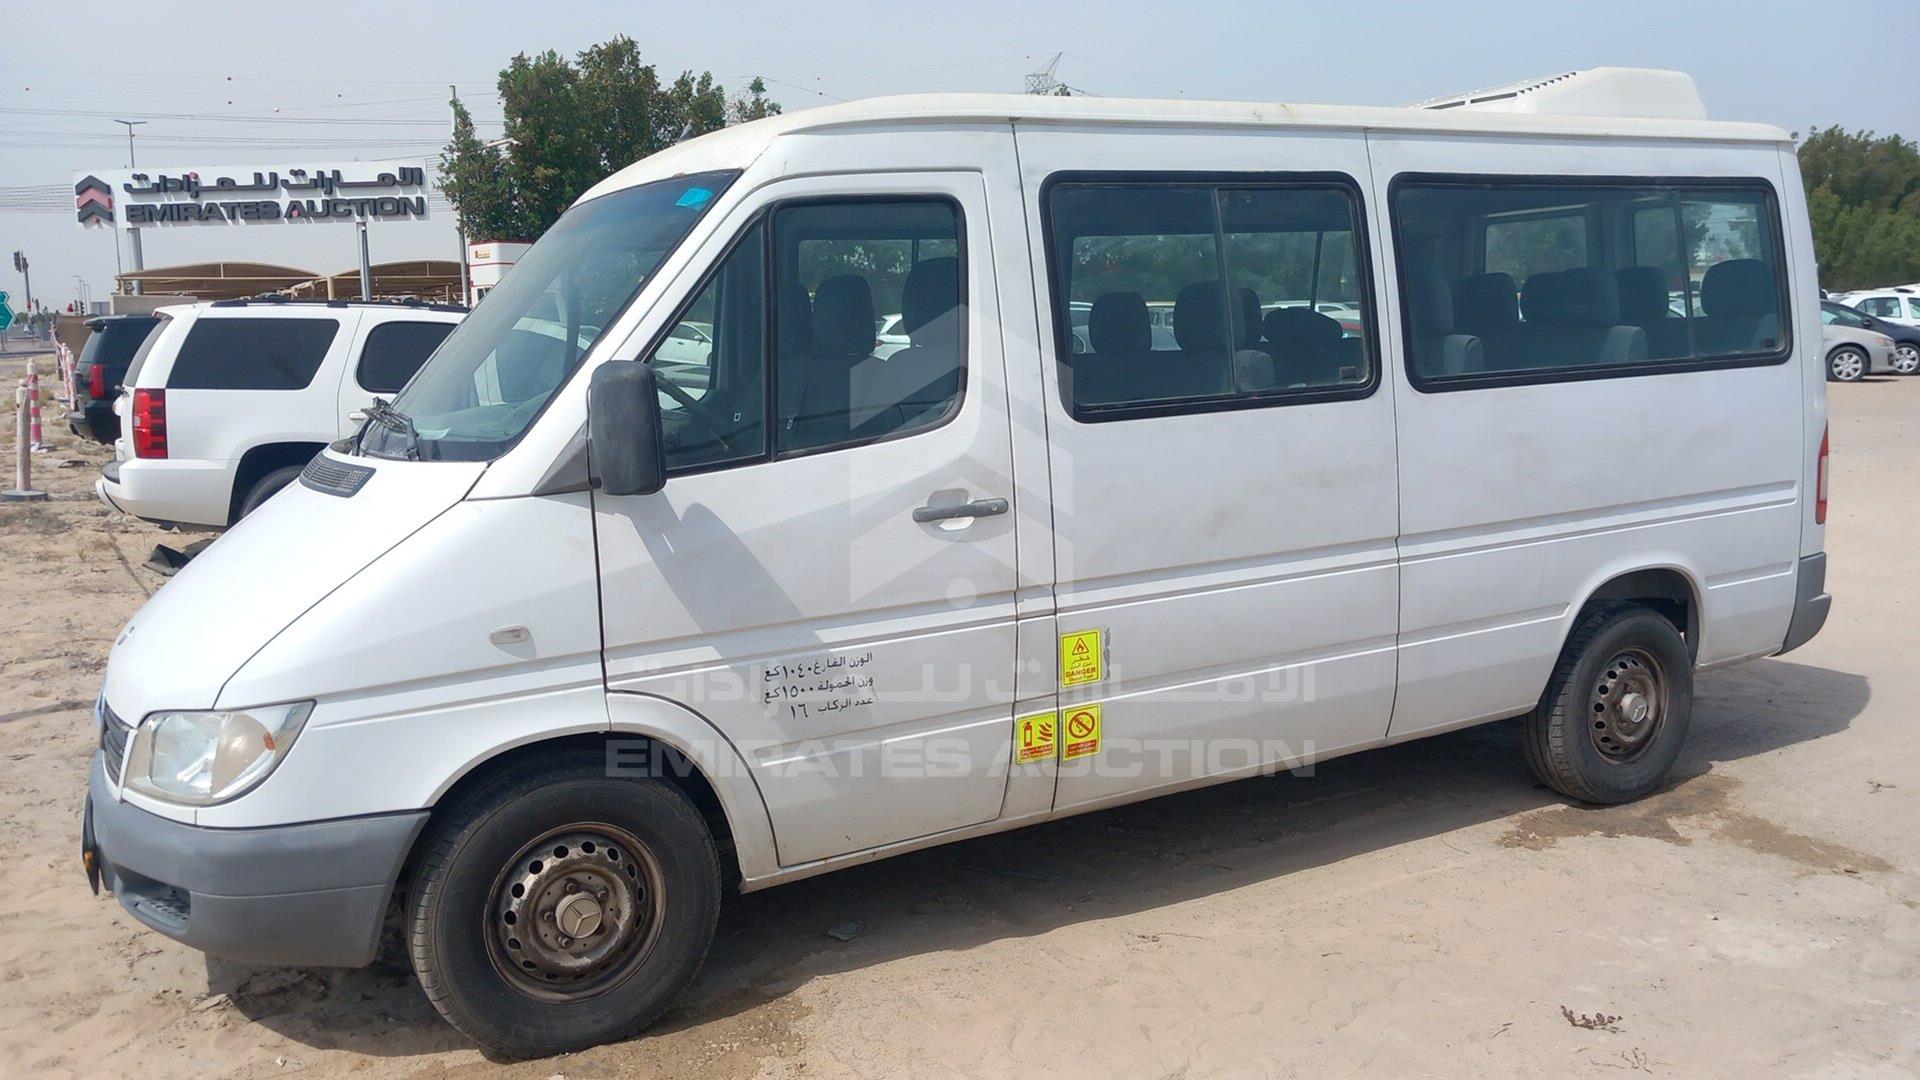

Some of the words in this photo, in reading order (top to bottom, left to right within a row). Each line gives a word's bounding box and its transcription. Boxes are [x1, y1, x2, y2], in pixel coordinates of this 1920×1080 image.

[124, 171, 278, 198] للمزادات
[125, 200, 280, 222] EMIRATES
[284, 196, 426, 220] AUCTION
[813, 657, 846, 674] الفارغ
[849, 652, 873, 668] الوزن
[1065, 666, 1096, 678] DANGER
[817, 676, 855, 692] الحمولة
[858, 677, 874, 687] وزن
[817, 698, 851, 714] الركاب
[855, 698, 873, 706] عدد
[790, 703, 808, 719] ١٦
